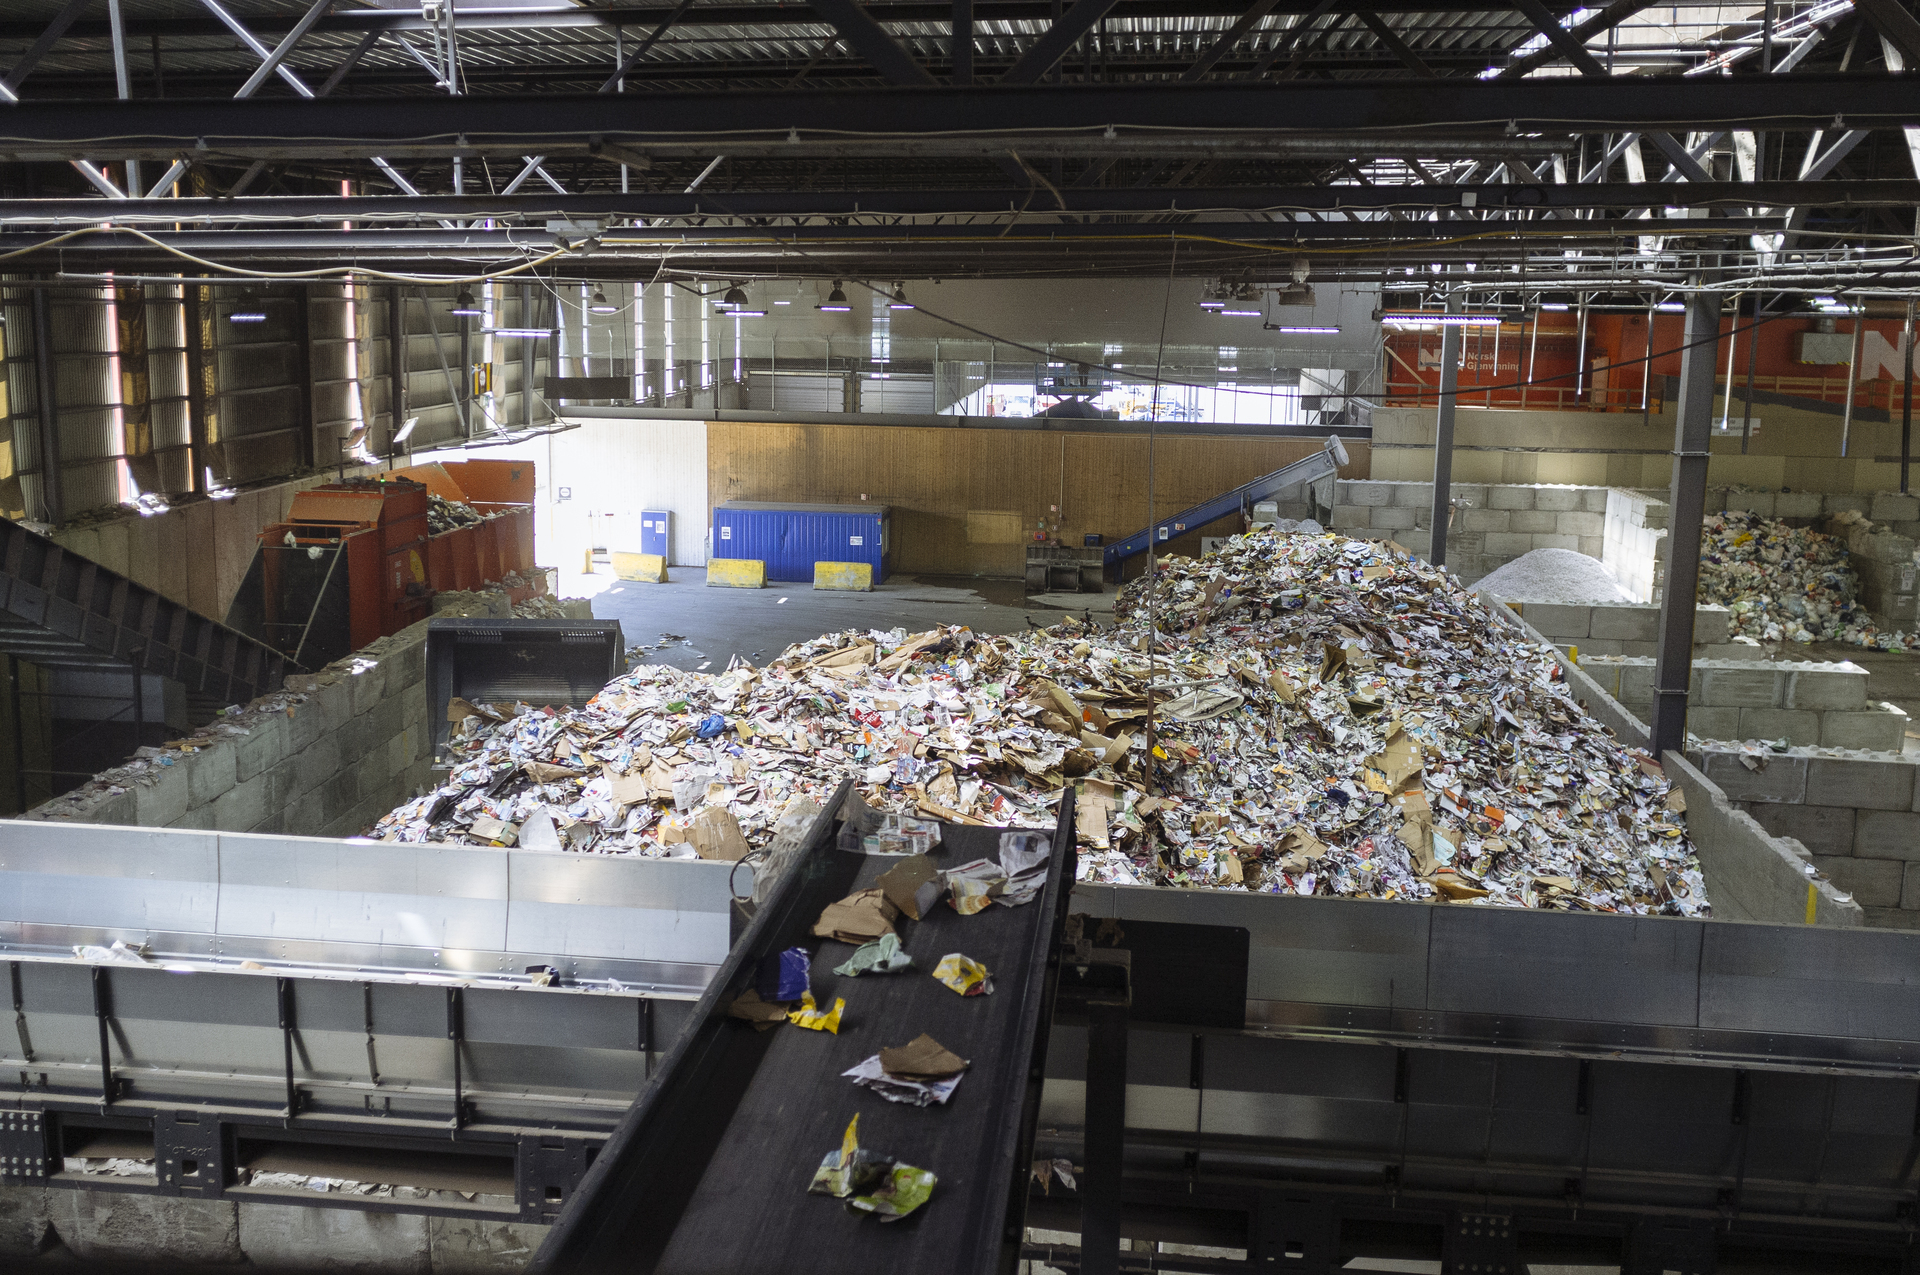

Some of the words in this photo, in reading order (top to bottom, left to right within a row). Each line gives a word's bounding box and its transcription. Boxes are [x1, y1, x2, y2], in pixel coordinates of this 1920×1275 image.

[1418, 349, 1464, 372] N
[1467, 352, 1496, 361] Norsk
[1860, 331, 1920, 380] N
[1467, 362, 1520, 372] Gjnvnning
